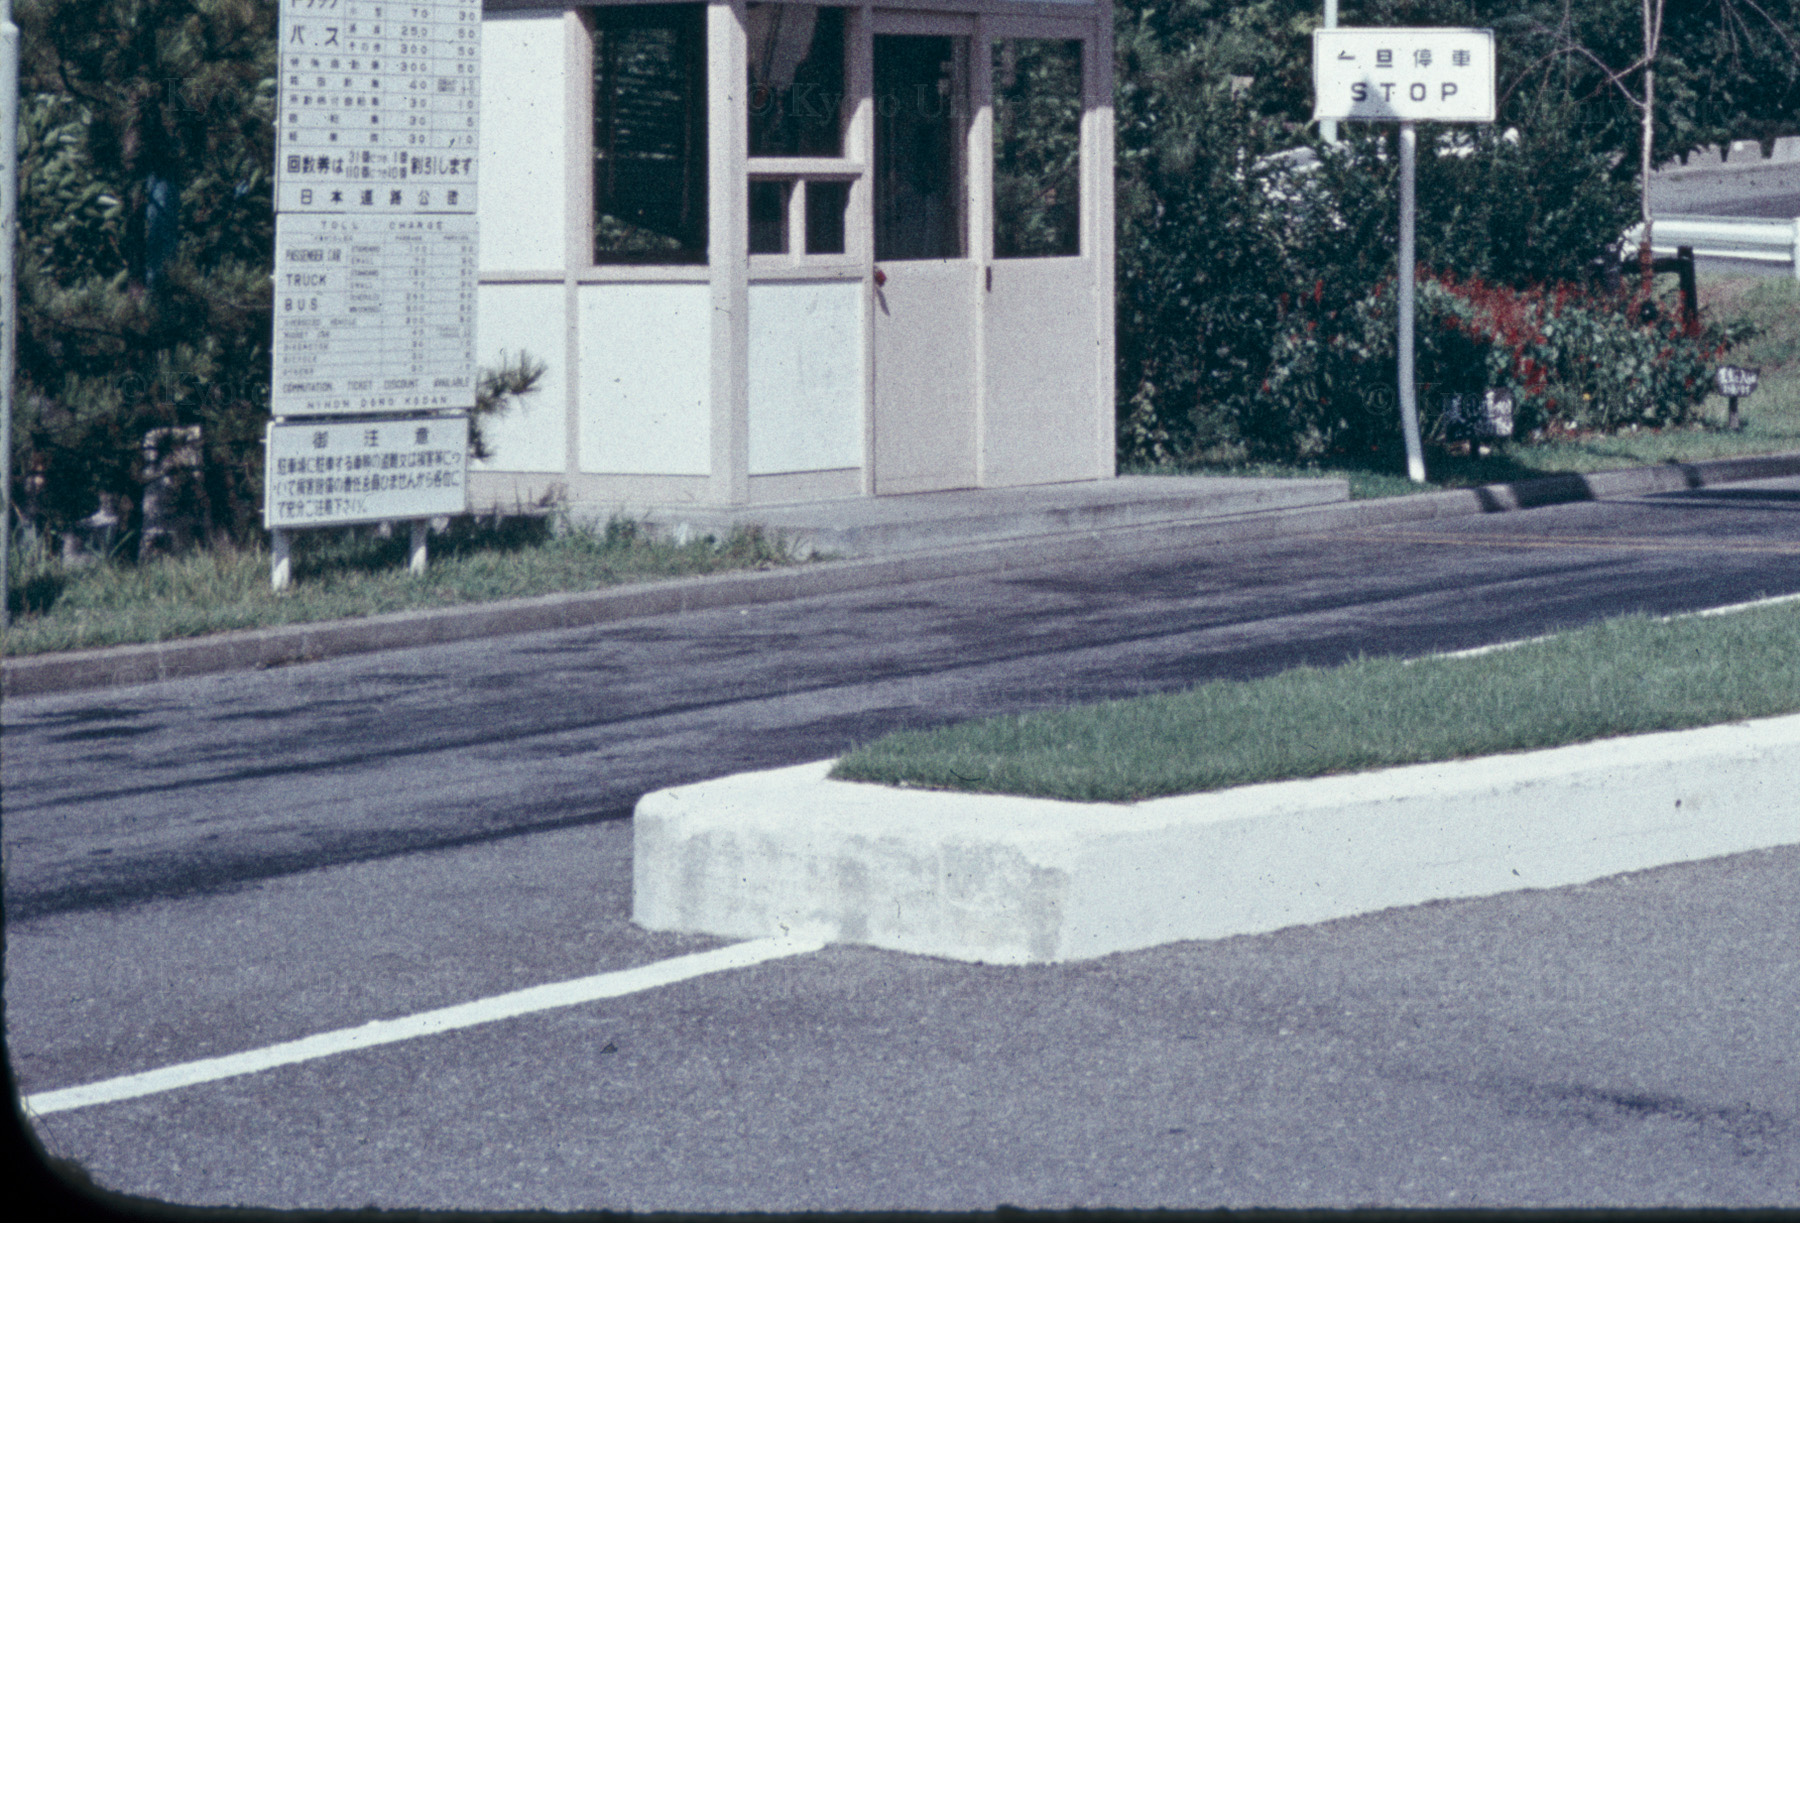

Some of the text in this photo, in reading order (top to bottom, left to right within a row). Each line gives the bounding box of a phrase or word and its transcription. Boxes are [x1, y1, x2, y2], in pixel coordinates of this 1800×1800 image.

[290, 25, 339, 47] バス
[1351, 82, 1458, 102] STOP
[287, 154, 344, 174] 回数券は
[411, 155, 472, 175] 割引します
[286, 273, 327, 287] TRUCK
[284, 297, 318, 312] BUS
[313, 427, 430, 449] 御注意
